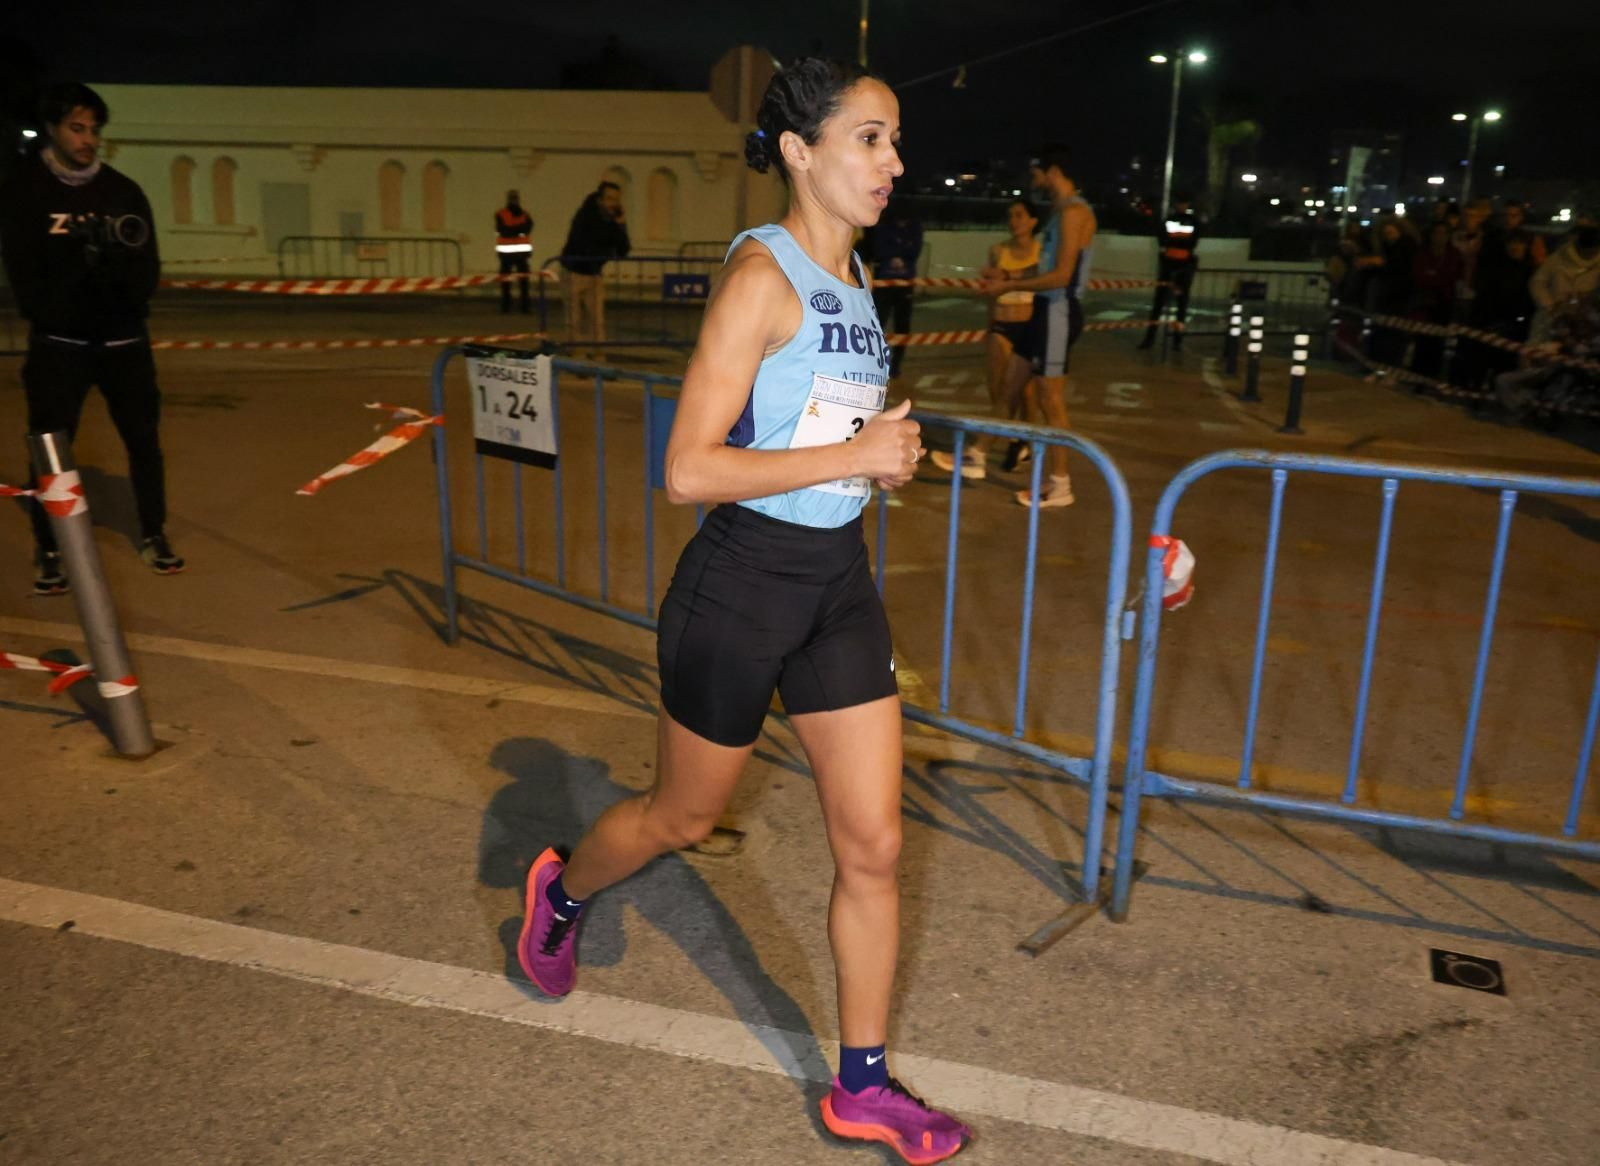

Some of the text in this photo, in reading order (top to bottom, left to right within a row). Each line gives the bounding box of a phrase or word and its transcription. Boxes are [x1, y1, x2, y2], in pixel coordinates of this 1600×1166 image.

[811, 293, 842, 311] TROPS
[477, 363, 538, 386] DORSALES
[478, 385, 488, 413] 1
[505, 390, 539, 422] 24
